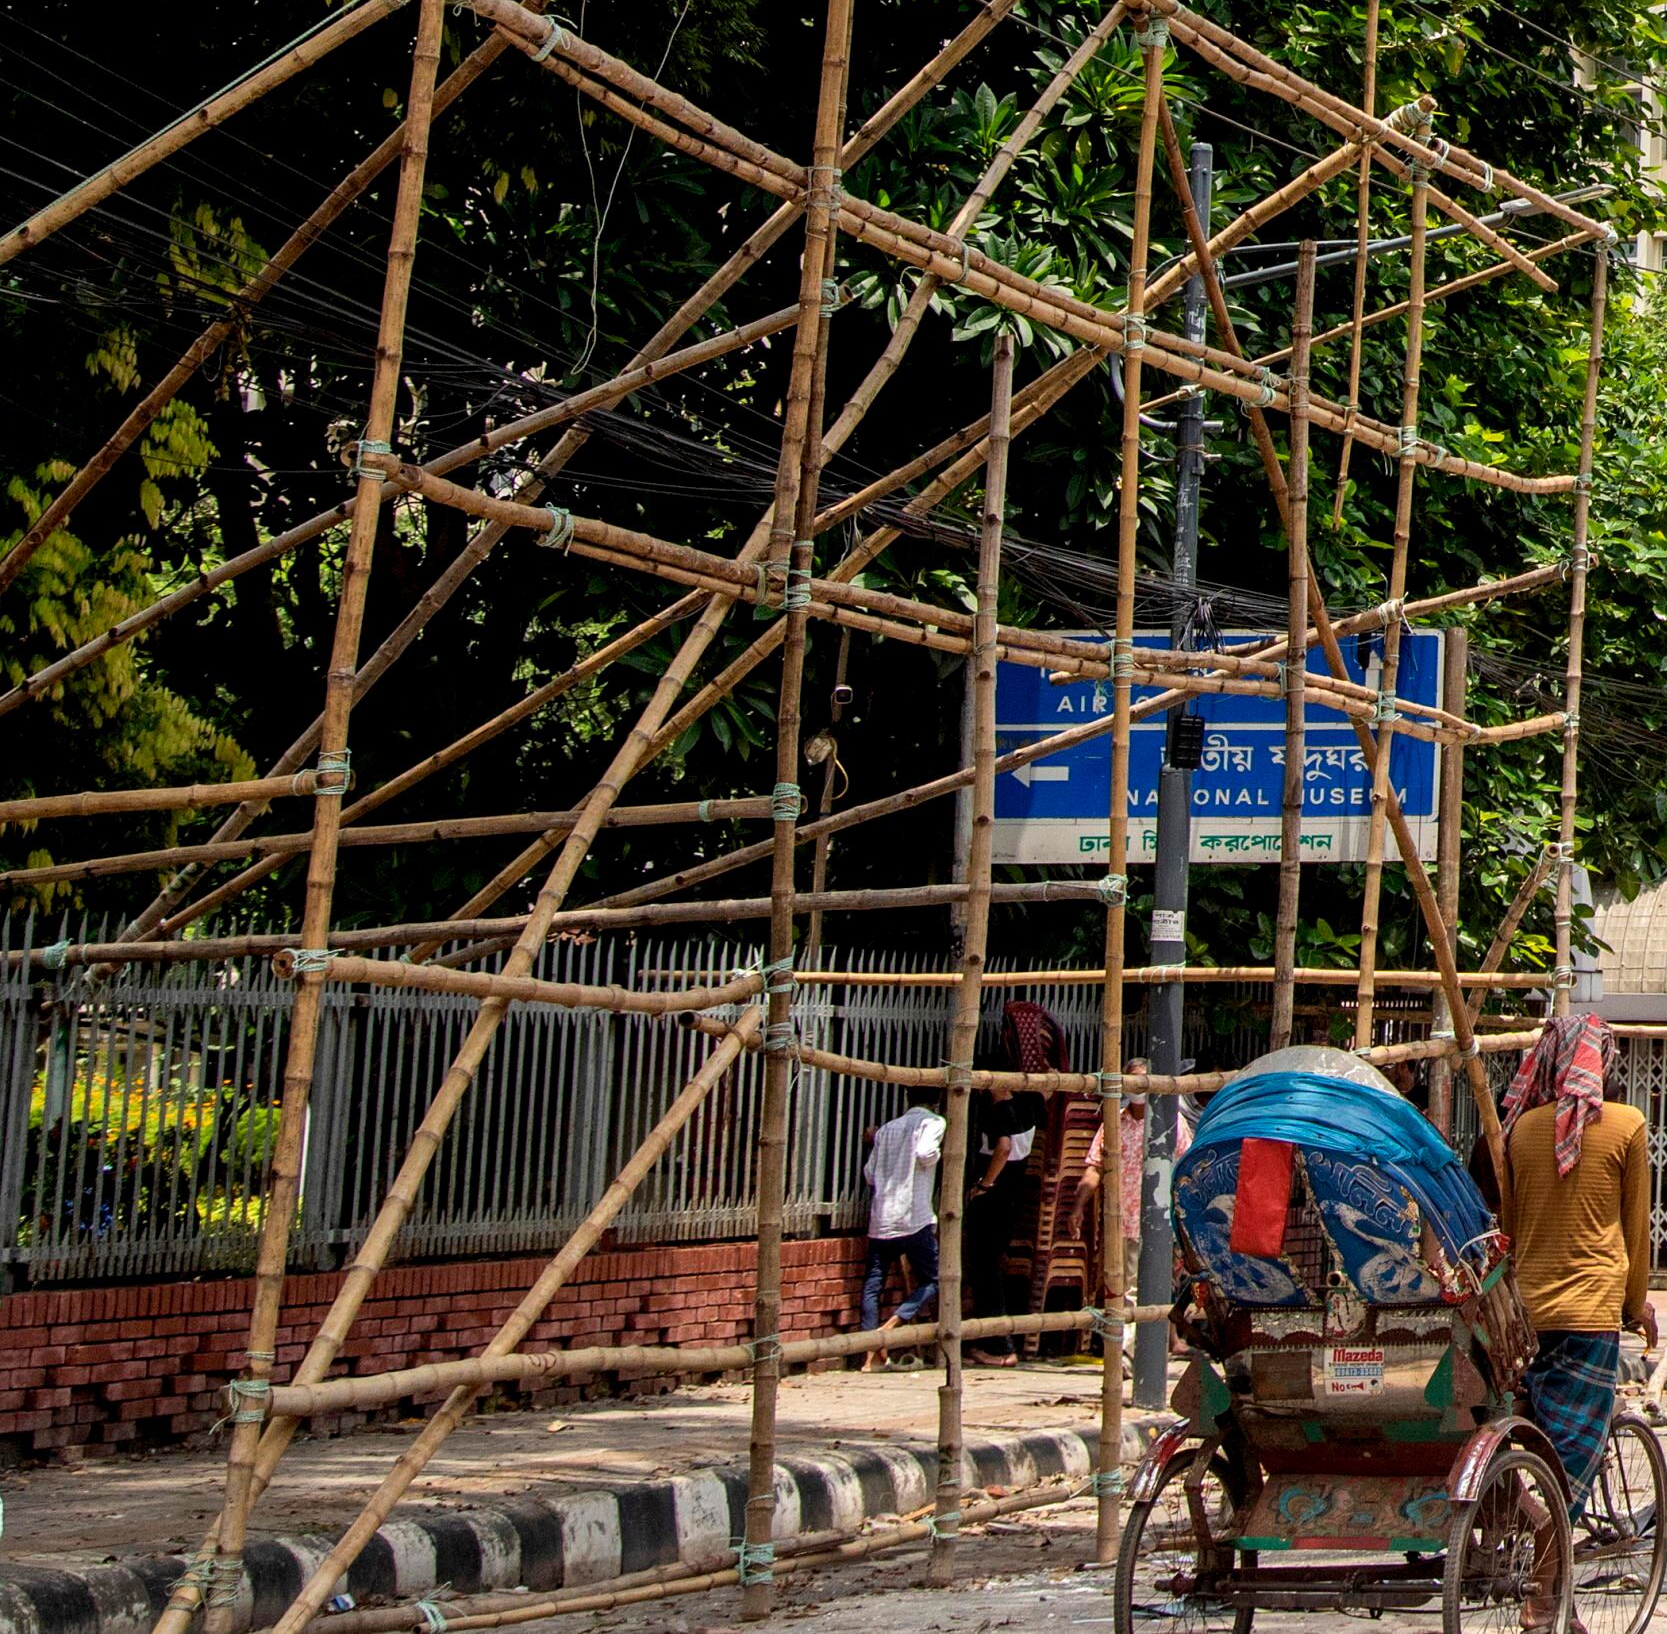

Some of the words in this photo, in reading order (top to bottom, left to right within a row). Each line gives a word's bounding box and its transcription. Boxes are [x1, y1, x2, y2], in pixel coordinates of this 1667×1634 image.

[1127, 788, 1269, 806] NAONAL
[1333, 1347, 1383, 1362] Mazeda
[1331, 1381, 1346, 1392] No
